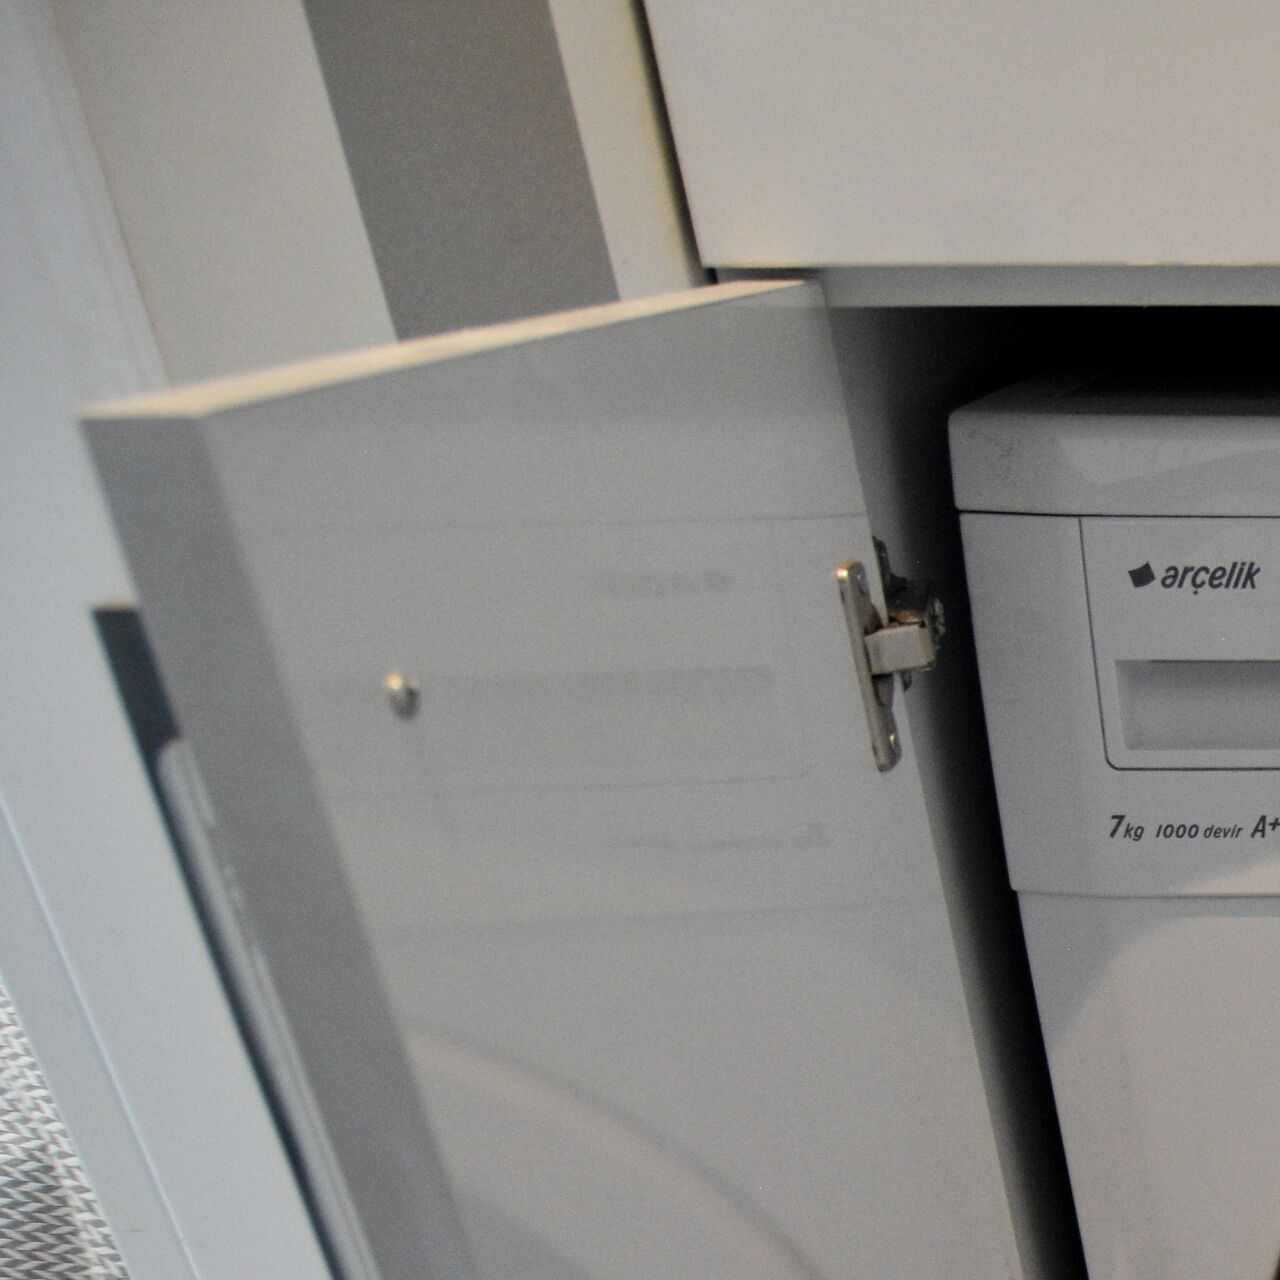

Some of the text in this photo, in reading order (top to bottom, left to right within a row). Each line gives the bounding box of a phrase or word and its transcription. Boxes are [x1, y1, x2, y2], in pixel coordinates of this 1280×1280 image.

[1161, 562, 1262, 595] arçelik
[1154, 823, 1200, 839] 1000
[1203, 823, 1245, 839] devir
